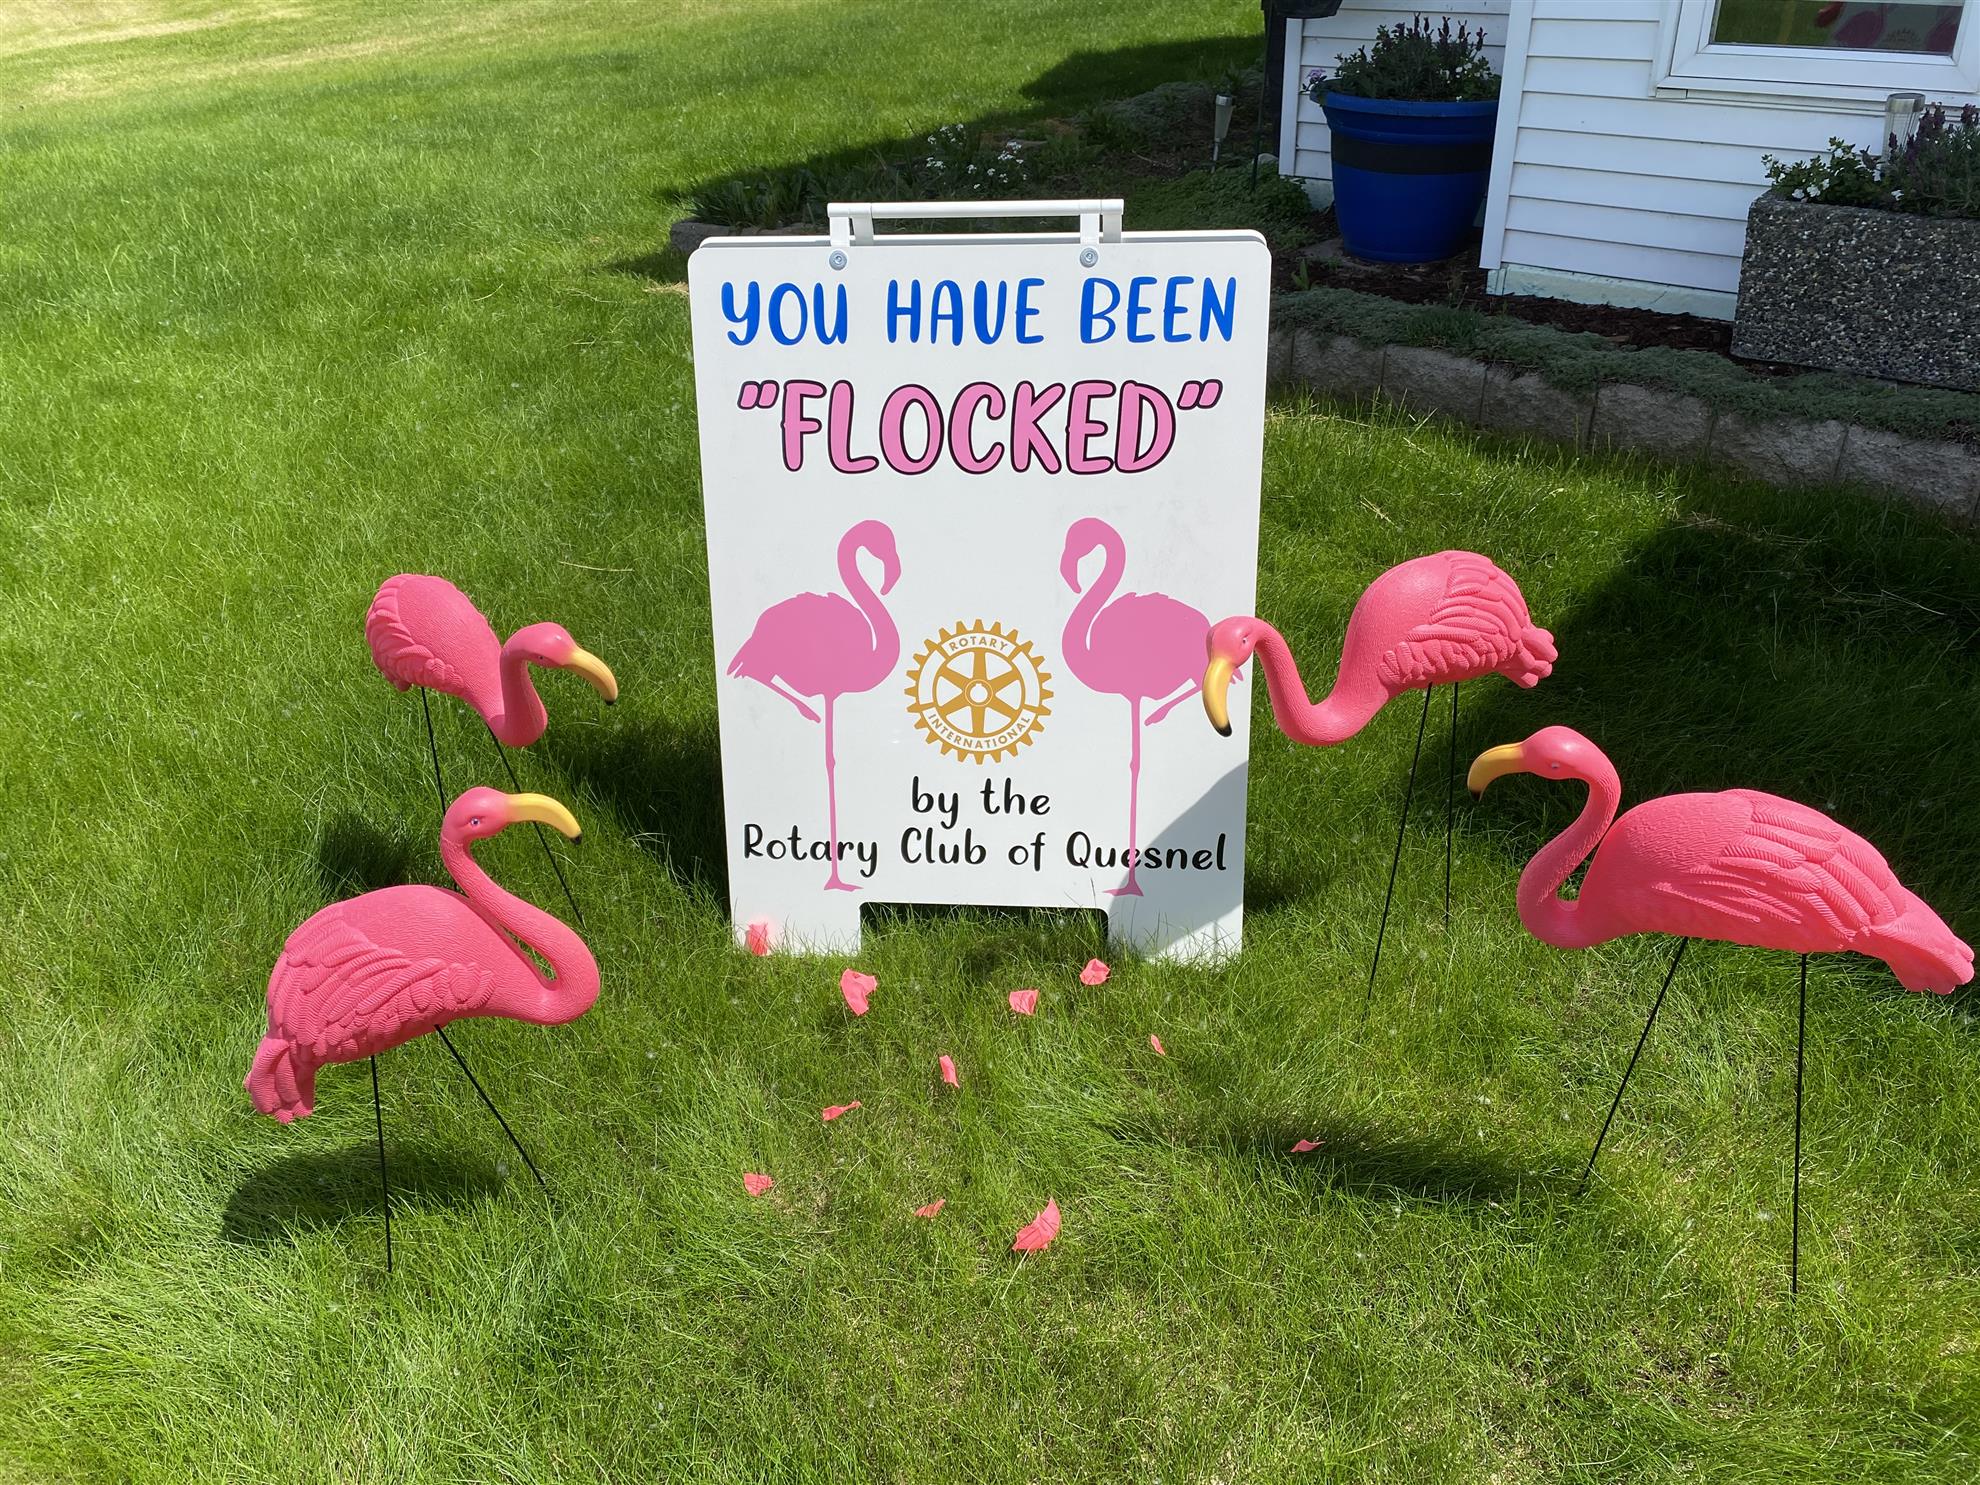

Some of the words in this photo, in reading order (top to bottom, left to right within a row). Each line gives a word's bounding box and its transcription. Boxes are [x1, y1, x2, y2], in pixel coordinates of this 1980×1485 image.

[720, 280, 849, 347] YOU
[886, 277, 1047, 347] HAVE
[1079, 275, 1238, 344] BEEN
[948, 635, 1009, 652] ROTARY
[927, 713, 1031, 750] INTERNATIONAL
[911, 776, 960, 830] by
[979, 778, 1051, 816] the
[743, 823, 878, 878] Rotary
[900, 827, 987, 865] Club
[1008, 831, 1046, 872] of
[1066, 831, 1228, 871] Quesnel
